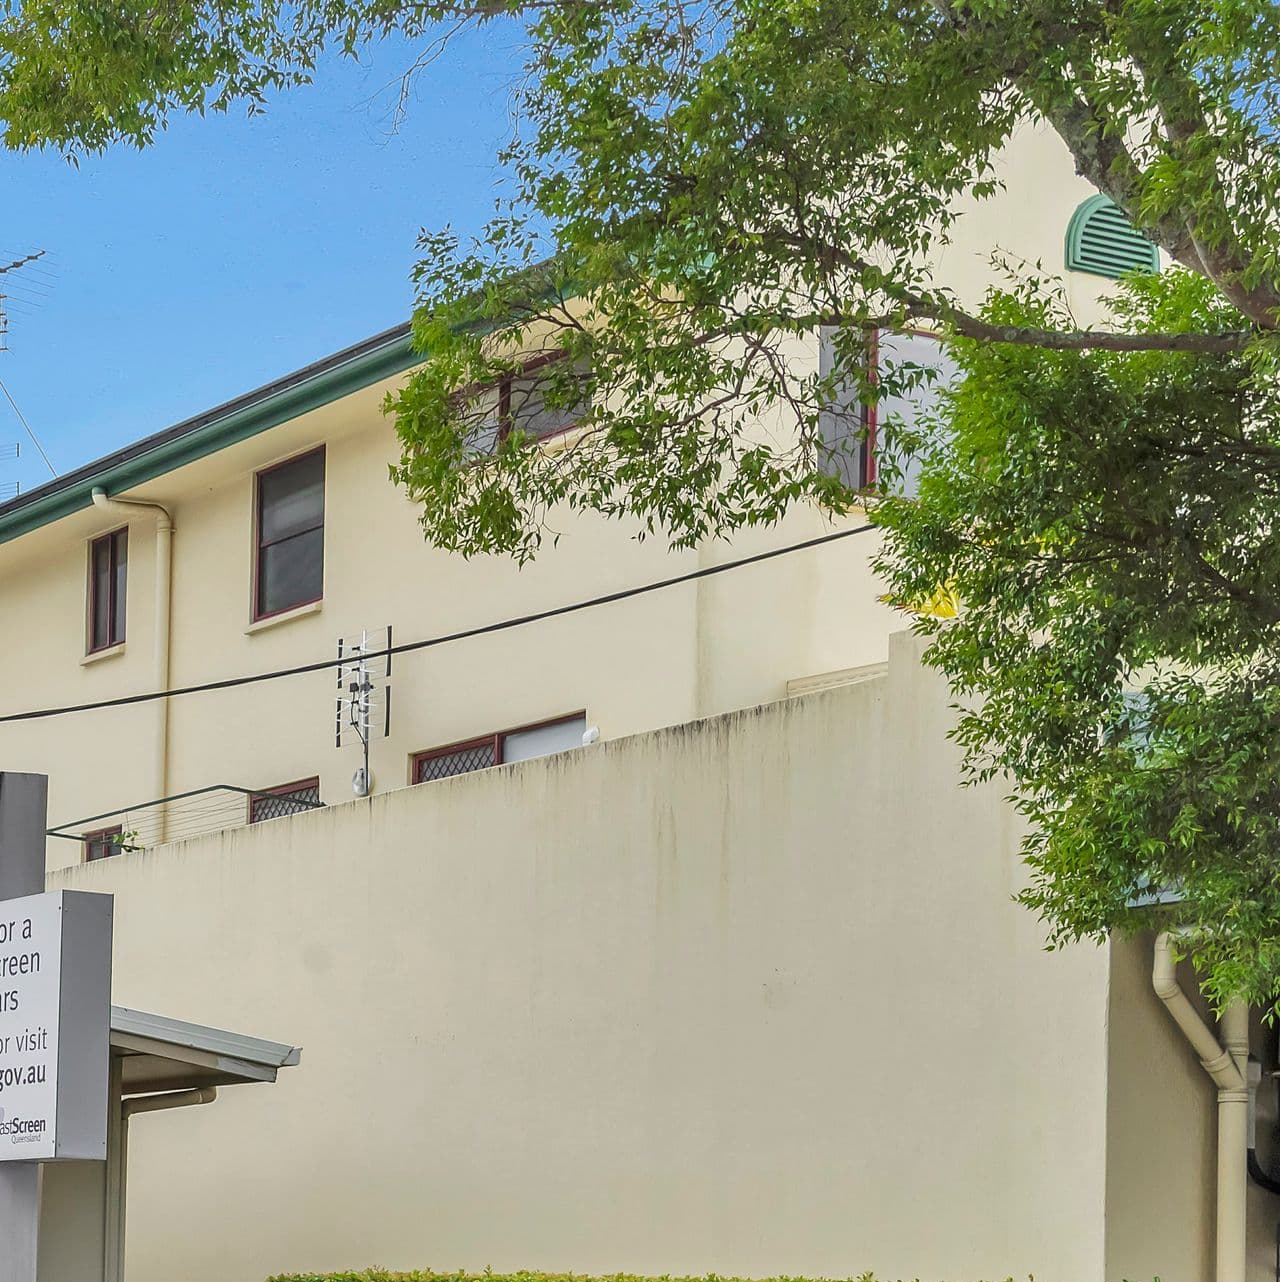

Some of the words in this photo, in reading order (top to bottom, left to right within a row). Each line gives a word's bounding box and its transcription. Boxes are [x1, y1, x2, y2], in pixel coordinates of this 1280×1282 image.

[22, 918, 32, 939] a
[16, 1026, 48, 1052] visit
[11, 1134, 41, 1145] Queensland
